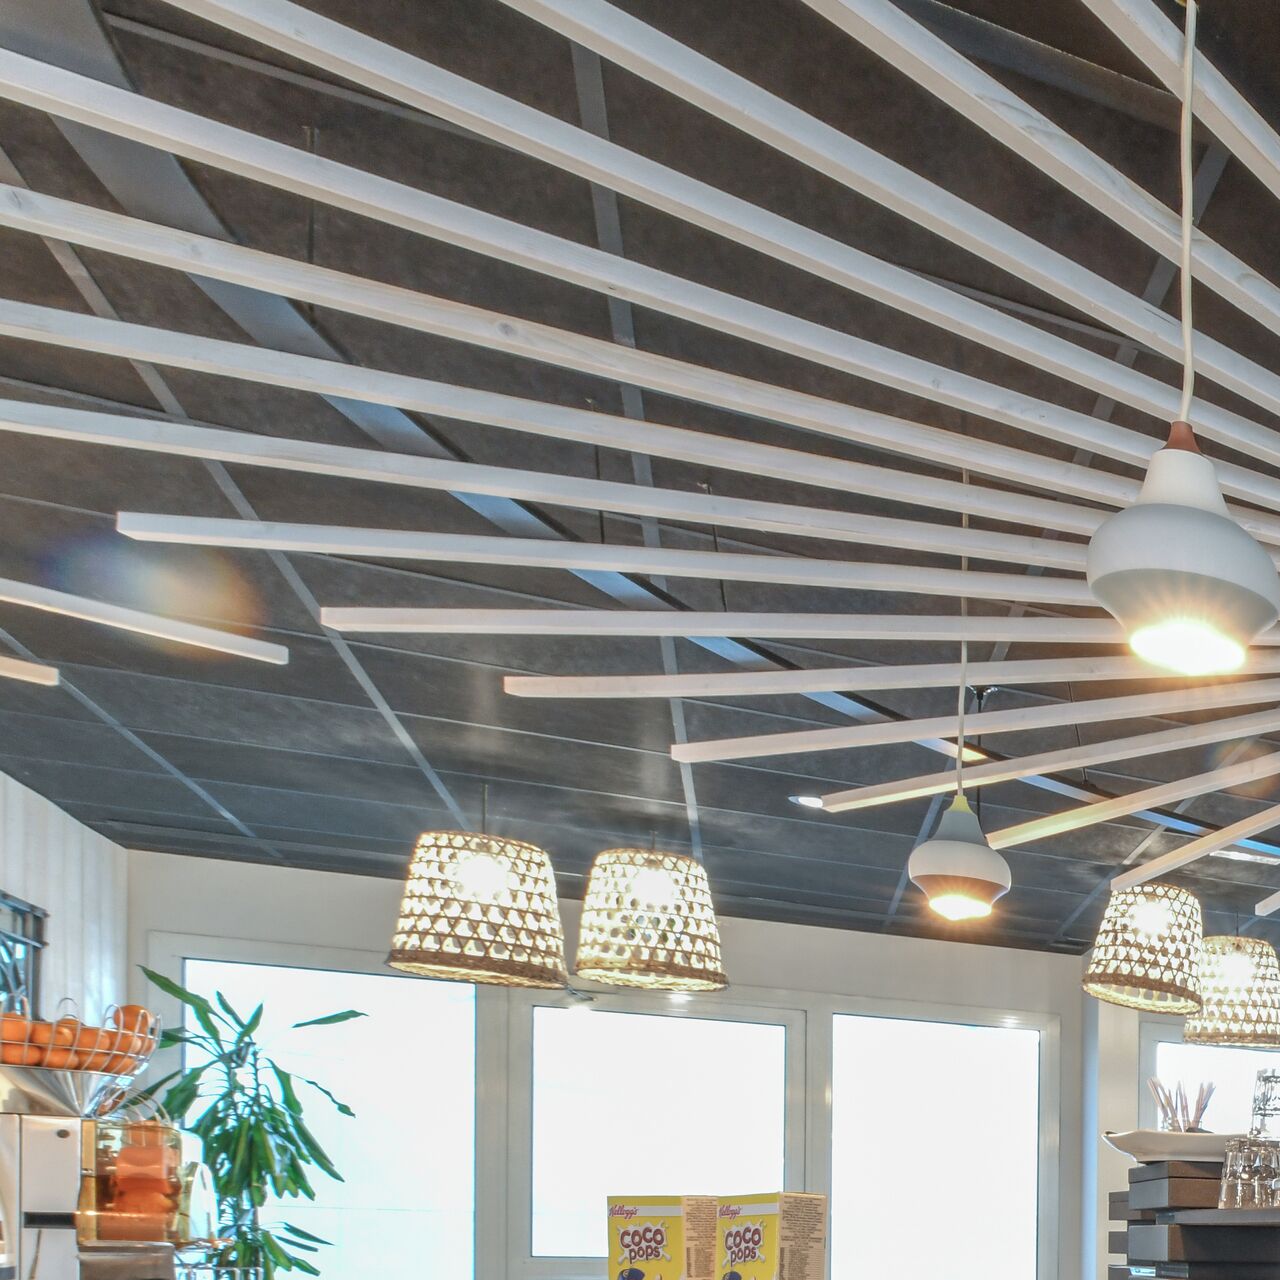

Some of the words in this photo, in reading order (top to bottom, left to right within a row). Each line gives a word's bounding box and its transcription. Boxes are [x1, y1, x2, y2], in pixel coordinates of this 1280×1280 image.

[620, 1227, 665, 1249] COCO
[725, 1226, 761, 1250] COCO
[629, 1244, 661, 1264] pops
[730, 1245, 757, 1267] pops
